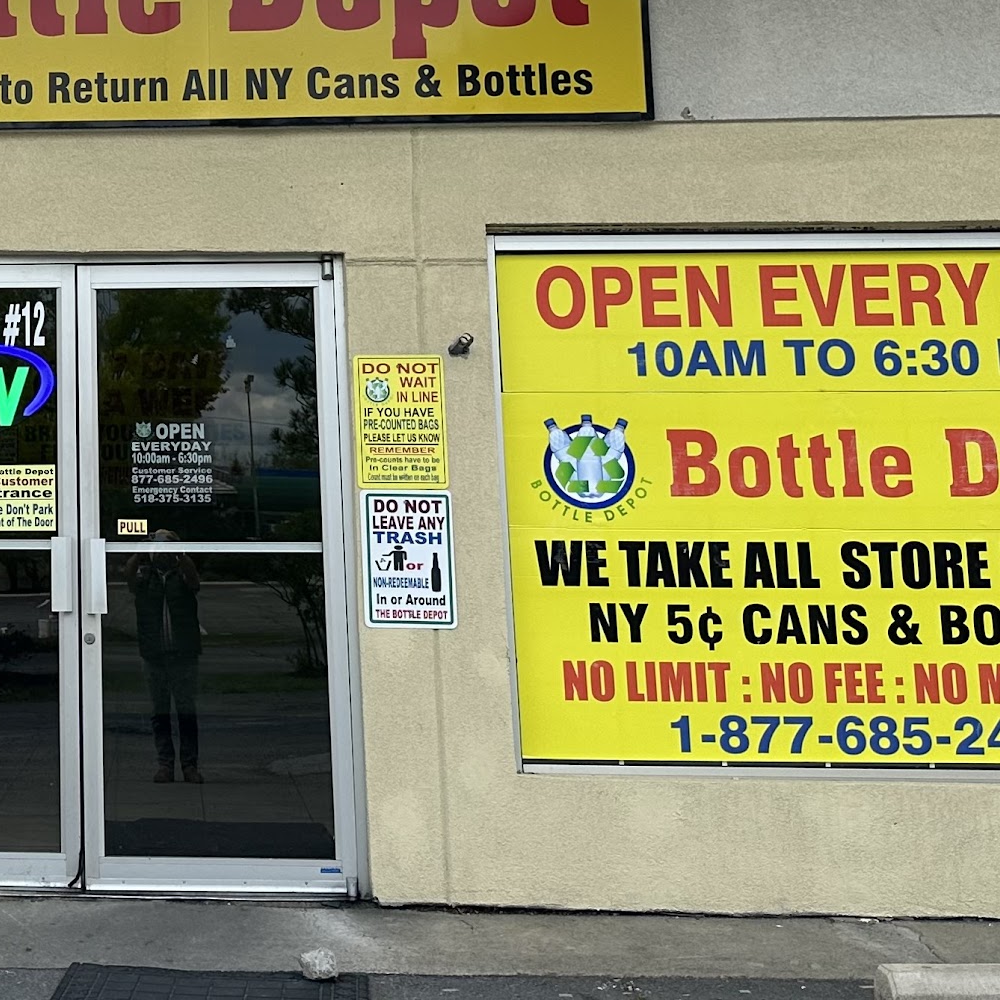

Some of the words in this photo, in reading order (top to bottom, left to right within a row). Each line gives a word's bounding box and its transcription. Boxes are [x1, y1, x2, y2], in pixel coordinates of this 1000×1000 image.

[0, 73, 33, 104] to
[49, 70, 169, 103] Return
[182, 67, 227, 101] All
[247, 67, 294, 100] NY
[307, 65, 399, 99] Cans
[415, 66, 442, 97] &
[456, 63, 593, 96] Bottles
[535, 265, 733, 329] OPEN
[759, 263, 989, 327] EVERY
[3, 301, 45, 347] #12
[627, 340, 767, 377] 10AM
[784, 340, 856, 376] TO
[874, 339, 980, 376] 6:30
[362, 363, 390, 374] DO
[397, 363, 438, 374] NOT
[400, 377, 436, 388] WAIT
[397, 391, 408, 403] IN
[412, 391, 439, 402] LINE
[364, 408, 373, 417] IF
[377, 408, 400, 417] YOU
[404, 408, 434, 417] HAVE
[364, 419, 416, 430] PRE-COUNTED
[418, 419, 439, 430] BAGS
[156, 423, 205, 439] OPEN
[364, 433, 390, 442] PLEASE
[393, 433, 405, 442] LET
[408, 433, 416, 442] US
[419, 433, 440, 442] KNOW
[132, 442, 211, 451] EVERYDAY
[132, 452, 170, 463] 10:00am
[178, 452, 212, 465] 6:30pm
[667, 429, 914, 498] Bottle
[411, 464, 437, 472] Bags
[132, 475, 213, 483] 877-685-2496
[132, 486, 177, 495] Emergency
[134, 494, 211, 502] 518-375-3135
[531, 480, 592, 522] BOTTLE
[604, 477, 653, 521] DEPOT
[6, 504, 29, 515] Don't
[33, 504, 53, 515] Park
[374, 500, 398, 514] DO
[404, 500, 442, 513] NOT
[7, 517, 15, 526] of
[17, 518, 32, 526] The
[35, 517, 53, 526] Door
[119, 522, 146, 533] PULL
[373, 516, 414, 530] LEAVE
[418, 516, 445, 530] ANY
[373, 531, 442, 544] TRASH
[406, 561, 424, 570] or
[535, 540, 609, 588] WE
[619, 541, 733, 588] TAKE
[744, 542, 820, 588] ALL
[840, 541, 991, 589] STORE
[373, 577, 429, 589] NON-REDEEMABLE
[376, 594, 387, 605] In
[391, 596, 402, 605] or
[405, 594, 445, 606] Around
[375, 610, 390, 618] THE
[393, 610, 422, 619] BOTTLE
[424, 610, 448, 620] DEPOT
[589, 603, 649, 644] NY
[667, 604, 723, 650] 5¢
[742, 603, 869, 645] CANS
[887, 604, 920, 645] &
[562, 660, 616, 702] NO
[625, 661, 731, 703] LIMIT
[761, 662, 813, 704] NO
[825, 663, 886, 704] FEE
[914, 663, 967, 705] NO
